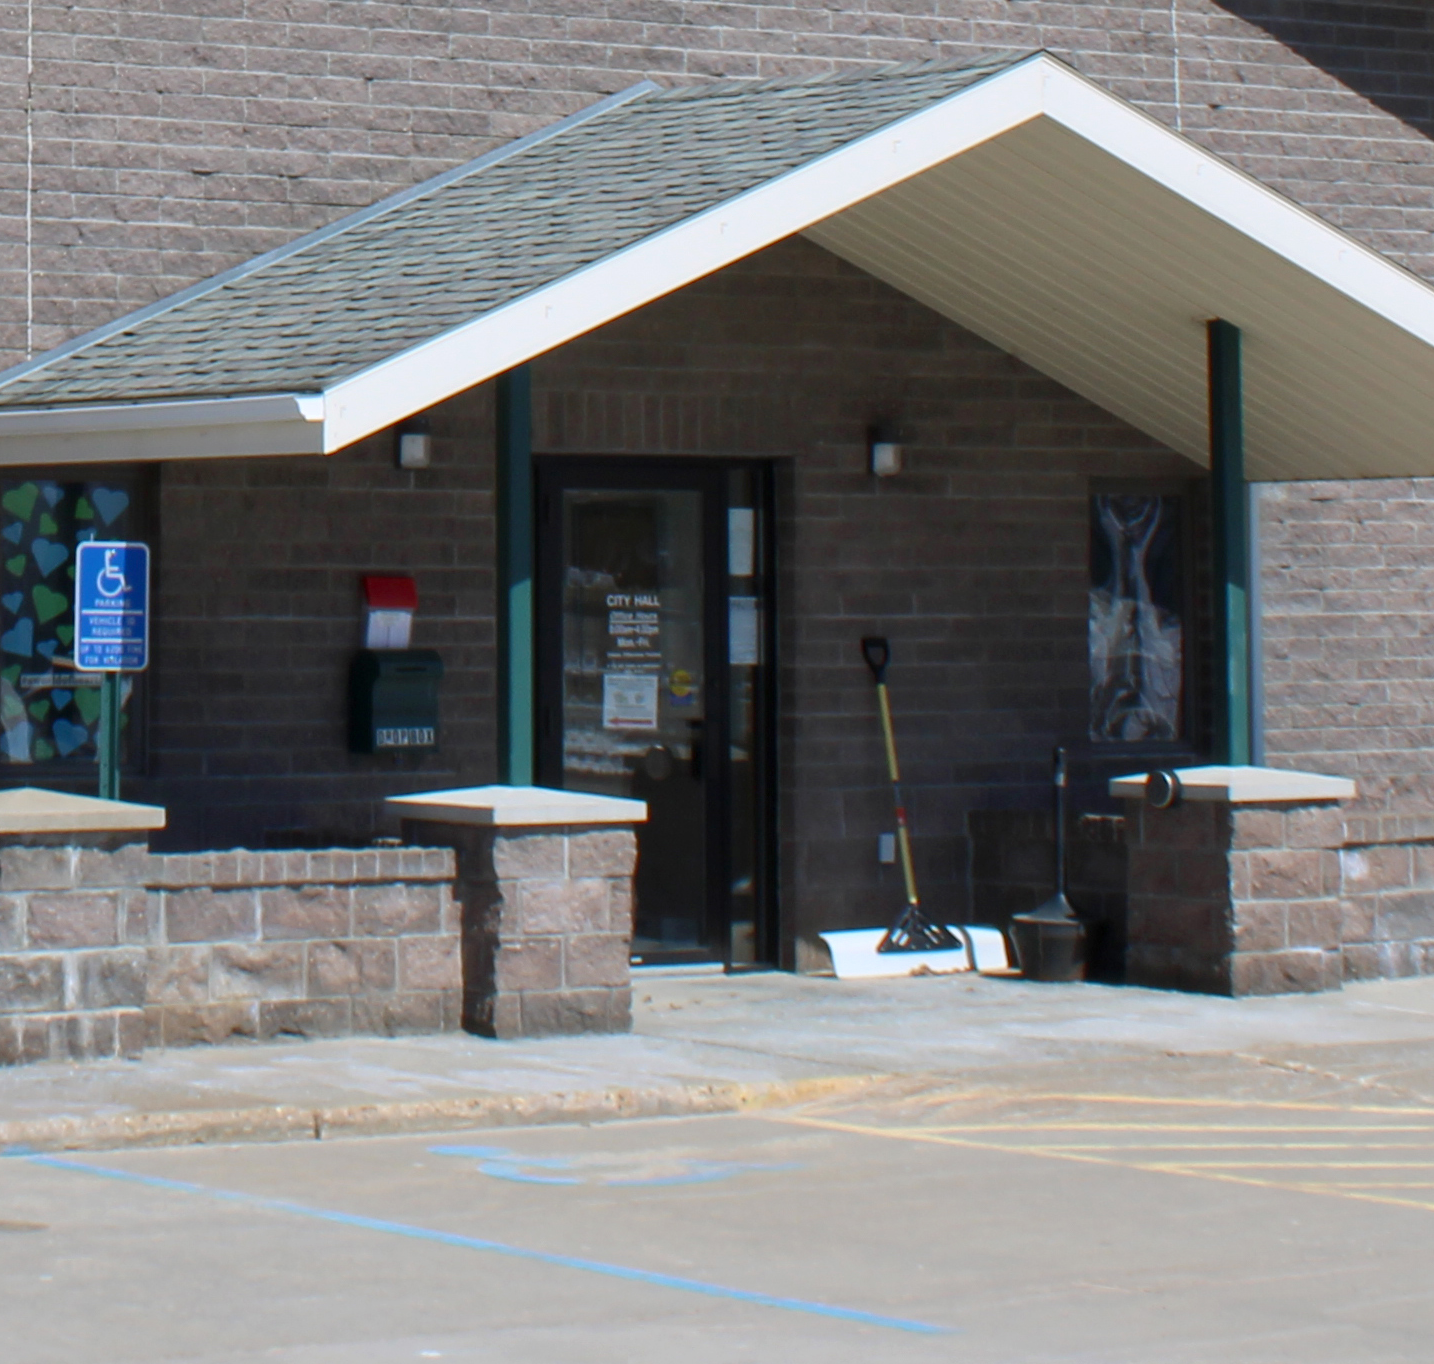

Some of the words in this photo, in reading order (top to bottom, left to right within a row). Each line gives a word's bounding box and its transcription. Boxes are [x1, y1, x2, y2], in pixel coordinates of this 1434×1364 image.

[94, 598, 132, 608] PARKING
[606, 594, 631, 607] CITY
[634, 594, 660, 607] HALL
[89, 617, 123, 626] VEHICLE
[92, 627, 132, 636] REQUIRED
